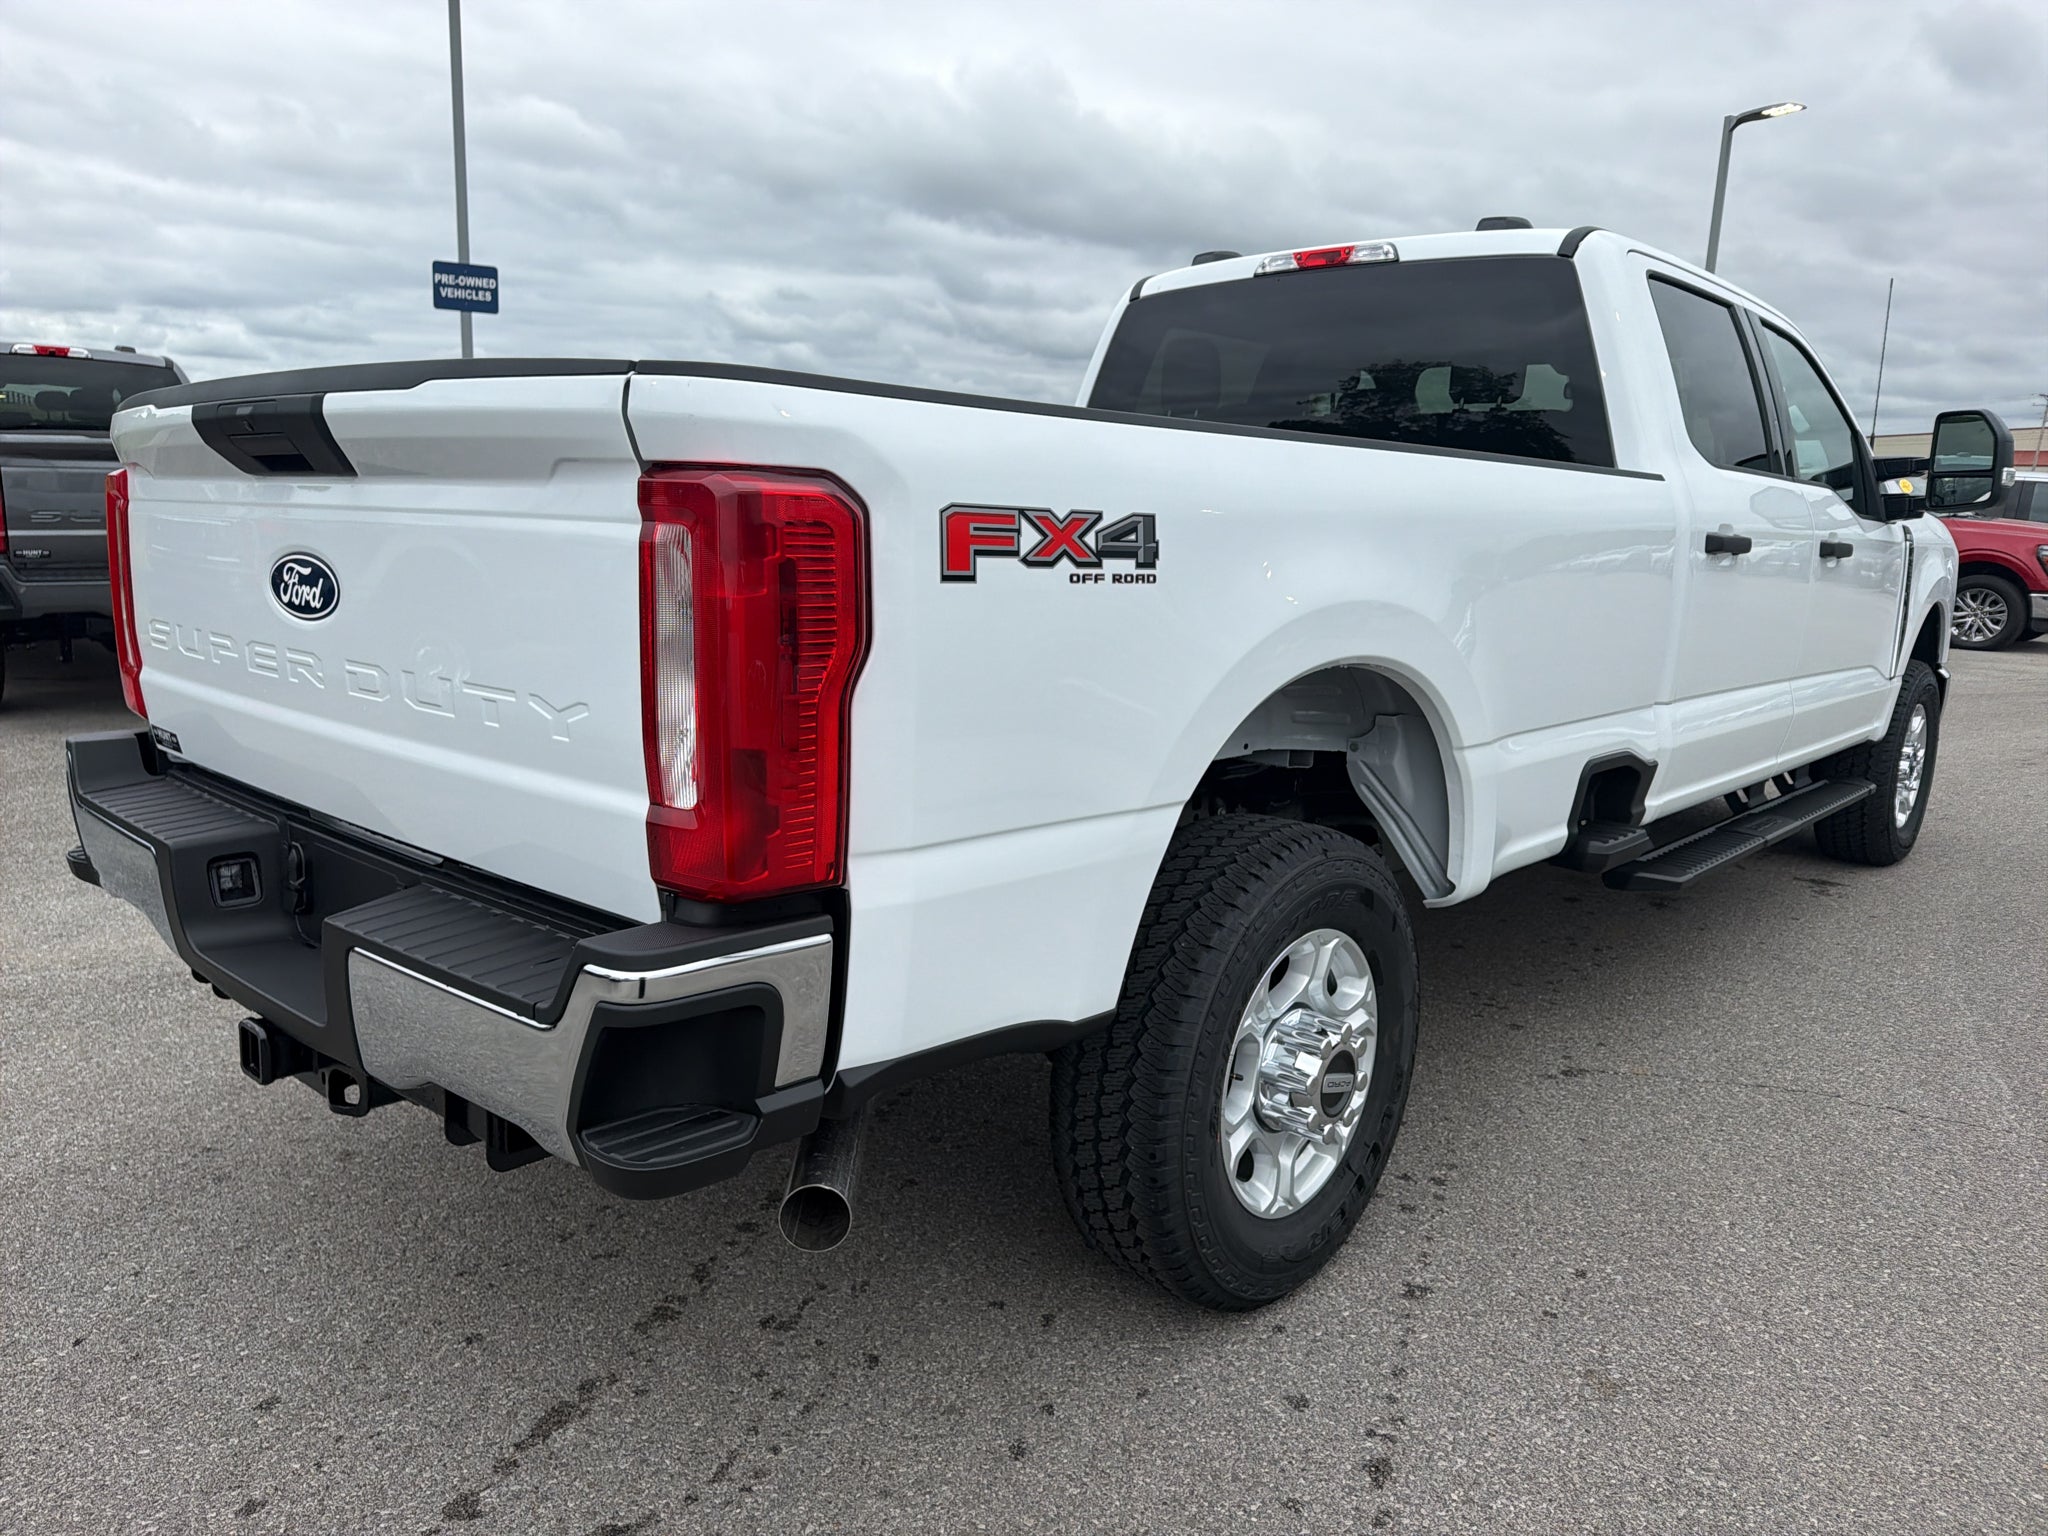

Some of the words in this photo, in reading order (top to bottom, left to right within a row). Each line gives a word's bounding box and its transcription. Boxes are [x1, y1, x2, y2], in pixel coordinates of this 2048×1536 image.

[434, 273, 496, 289] PRE-OWNED
[439, 286, 492, 302] VEHICLES
[939, 502, 1159, 584] FX4
[280, 562, 323, 609] Ford
[1069, 573, 1105, 584] OFF
[1112, 573, 1157, 584] ROAD
[148, 618, 325, 689] SUPER
[345, 658, 589, 742] DUTY
